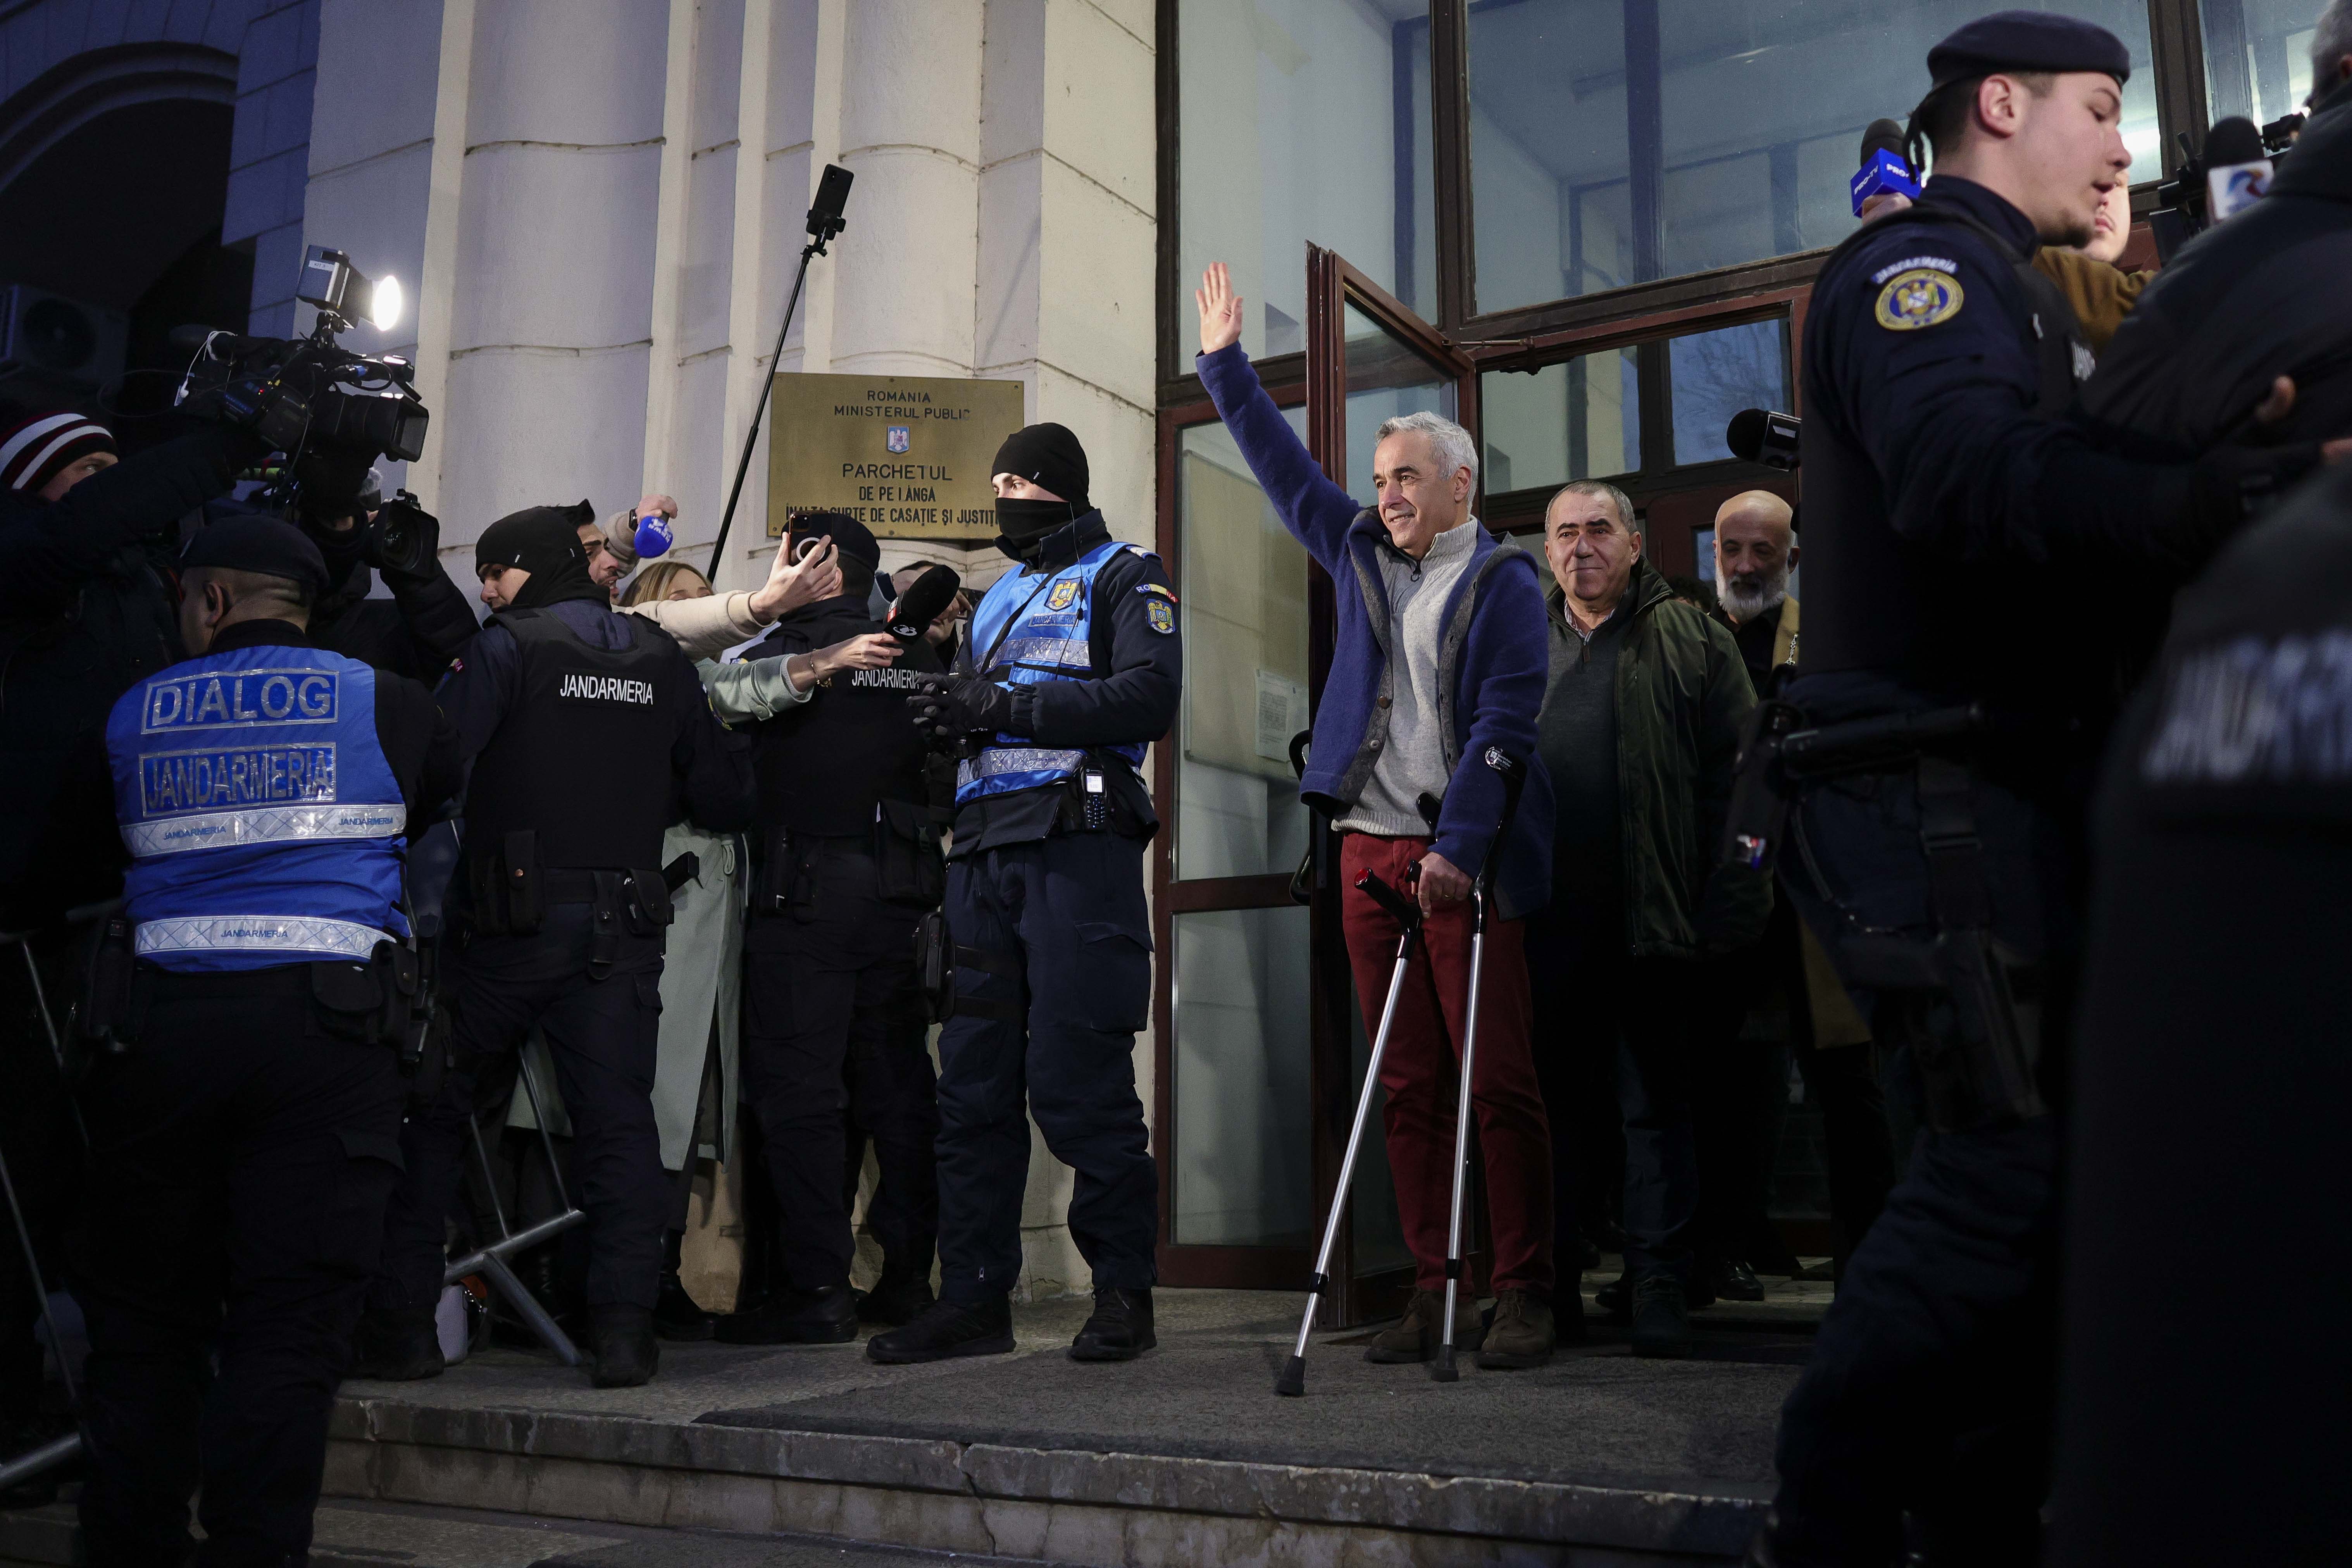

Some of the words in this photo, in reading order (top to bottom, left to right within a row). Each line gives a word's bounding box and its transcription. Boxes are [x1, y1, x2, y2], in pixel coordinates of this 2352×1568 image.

[867, 390, 930, 403] ROMÂNIA
[834, 405, 920, 418] MINISTERUL
[842, 463, 953, 481] PARCHETUL
[859, 486, 874, 501] DE
[879, 486, 894, 501] PE
[870, 508, 885, 522] DE
[890, 508, 937, 526] CASAȚIE
[942, 509, 952, 526] ȘI
[560, 674, 653, 705] JANDARMERIA
[152, 675, 331, 726] DIALOG
[146, 750, 333, 808] JANDARMERIA
[164, 826, 226, 840] JANDARMERIA
[221, 929, 288, 937] JANDARMERIA
